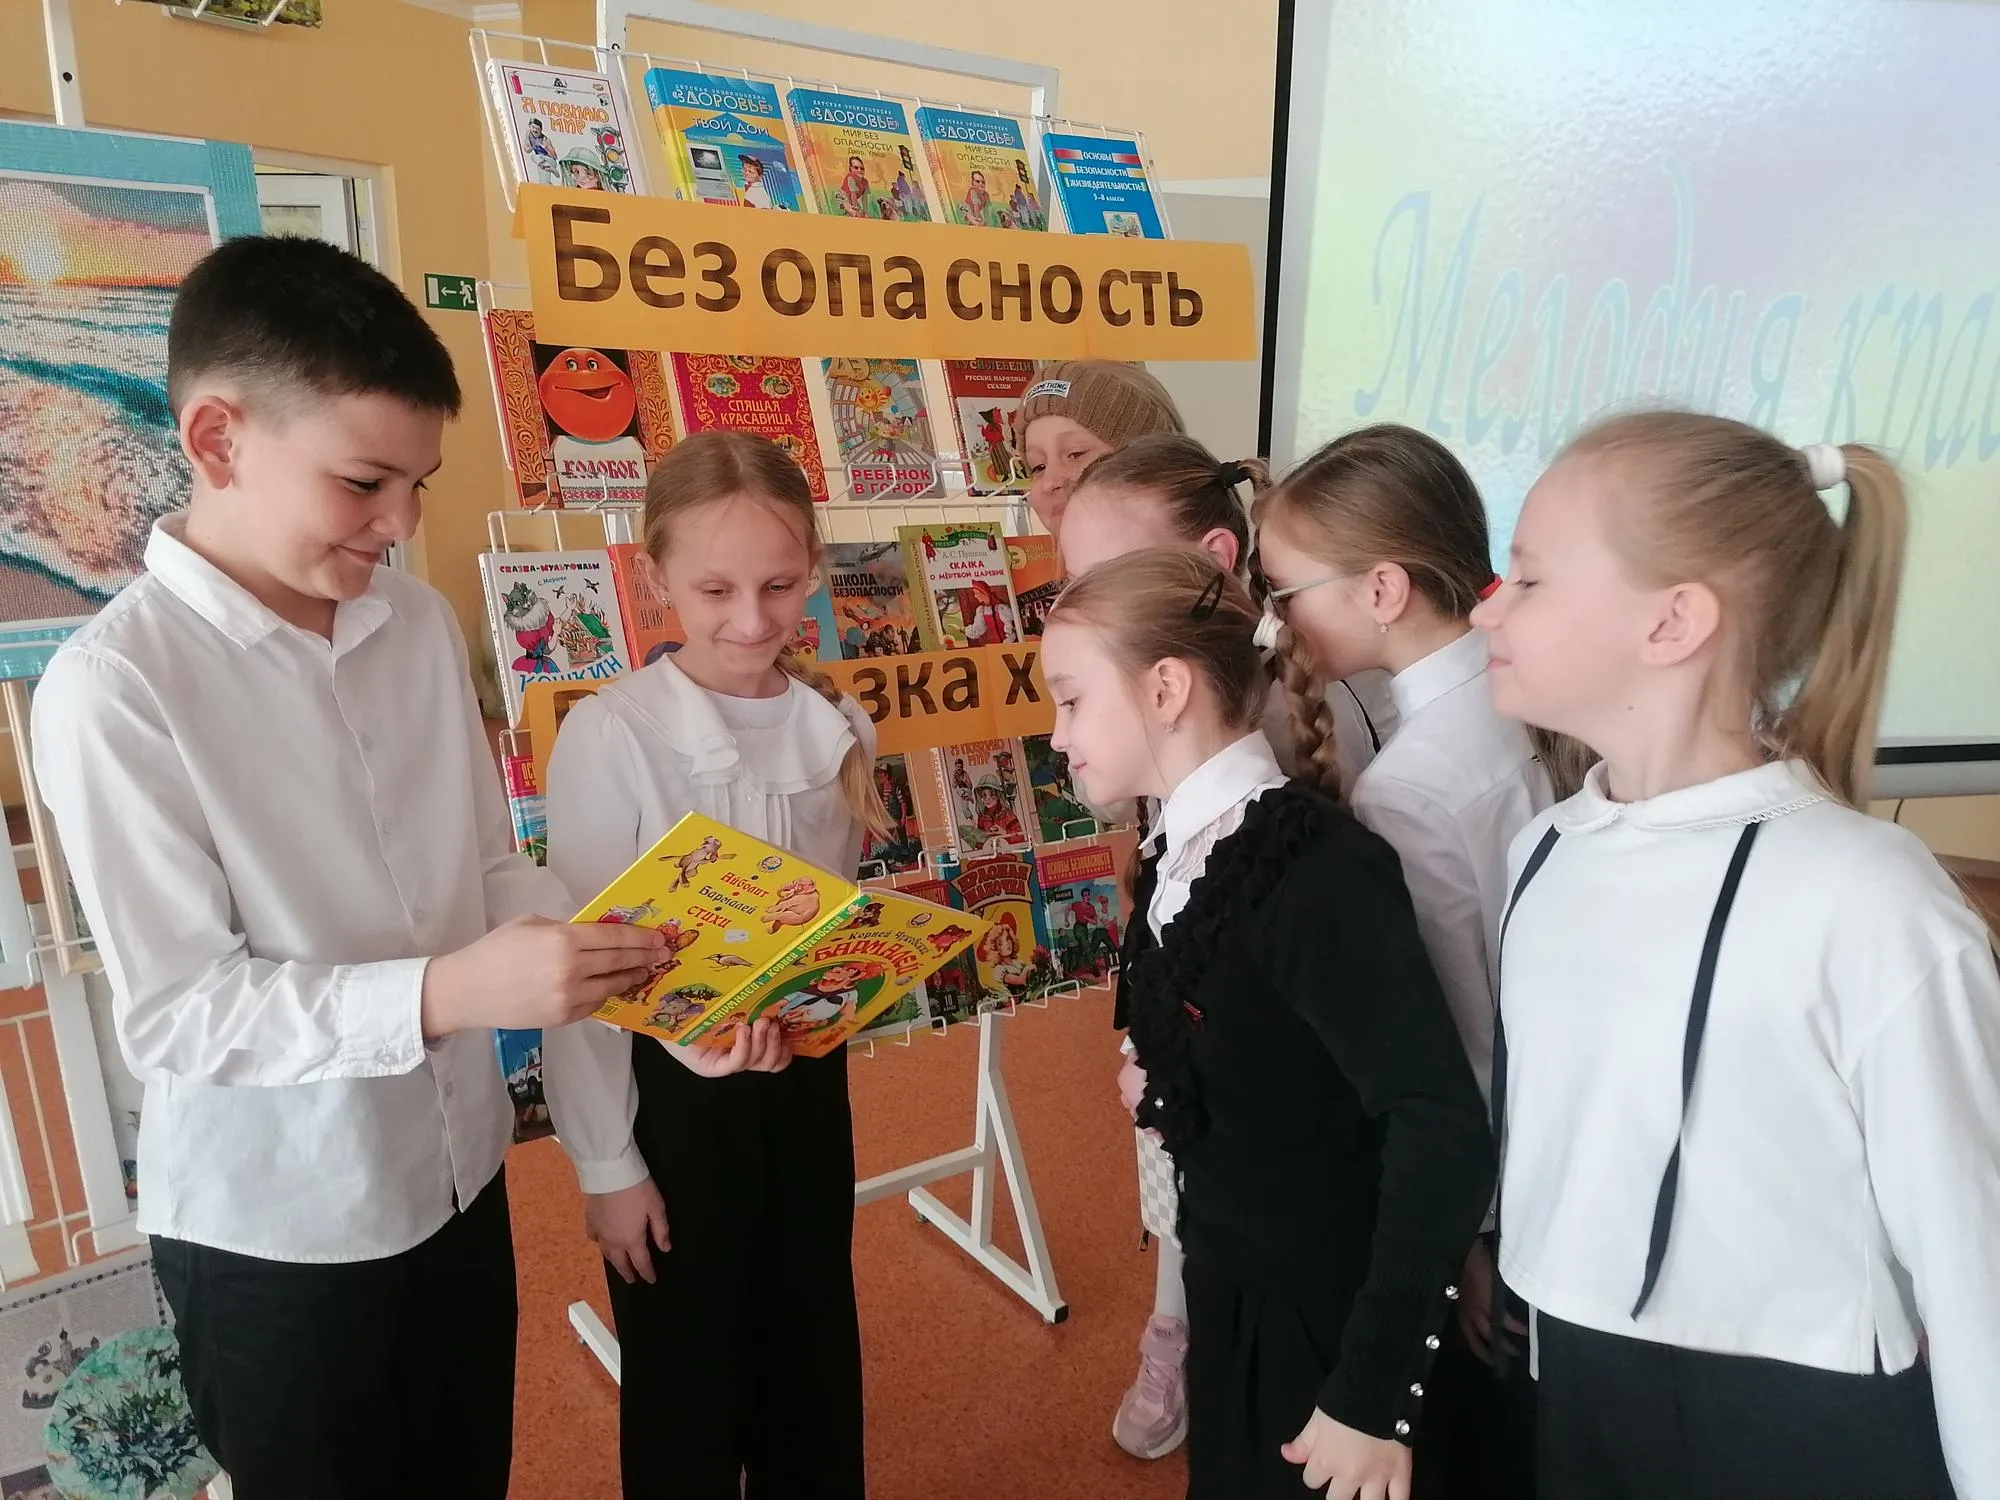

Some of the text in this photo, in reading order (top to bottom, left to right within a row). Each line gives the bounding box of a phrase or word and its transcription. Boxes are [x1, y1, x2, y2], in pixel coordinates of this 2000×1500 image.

[521, 97, 609, 123] Я ПОЗНАЮ
[550, 117, 586, 135] МИР
[693, 118, 770, 136] ТВОЙ ДОМ
[842, 129, 879, 140] МИР БЕЗ
[833, 138, 894, 152] ОПАСНОСТИ
[965, 145, 998, 156] МИР БЕЗ
[957, 154, 1011, 166] ОПАСНОСТИ
[1083, 151, 1113, 162] ОСНОВЫ
[1076, 166, 1128, 177] БЕЗОПАСНОСТИ
[728, 400, 780, 412] СПЯЩАЯ
[720, 413, 793, 425] КРАСАВИЦА
[563, 460, 640, 479] КОЛОБОК
[852, 467, 930, 480] РЕБЁНОК
[854, 483, 935, 495] В ГОРОДЕ
[949, 560, 985, 570] СКАЗКА
[831, 574, 877, 587] ШКОЛА
[833, 586, 904, 598] БЕЗОПАСНОСТИ
[720, 872, 770, 898] Айболит
[697, 885, 758, 915] Бармалей
[848, 930, 893, 940] Корней
[767, 950, 799, 977] Корней
[797, 914, 847, 953] Чуковский
[815, 940, 920, 977] БАРМАЛЕЙ
